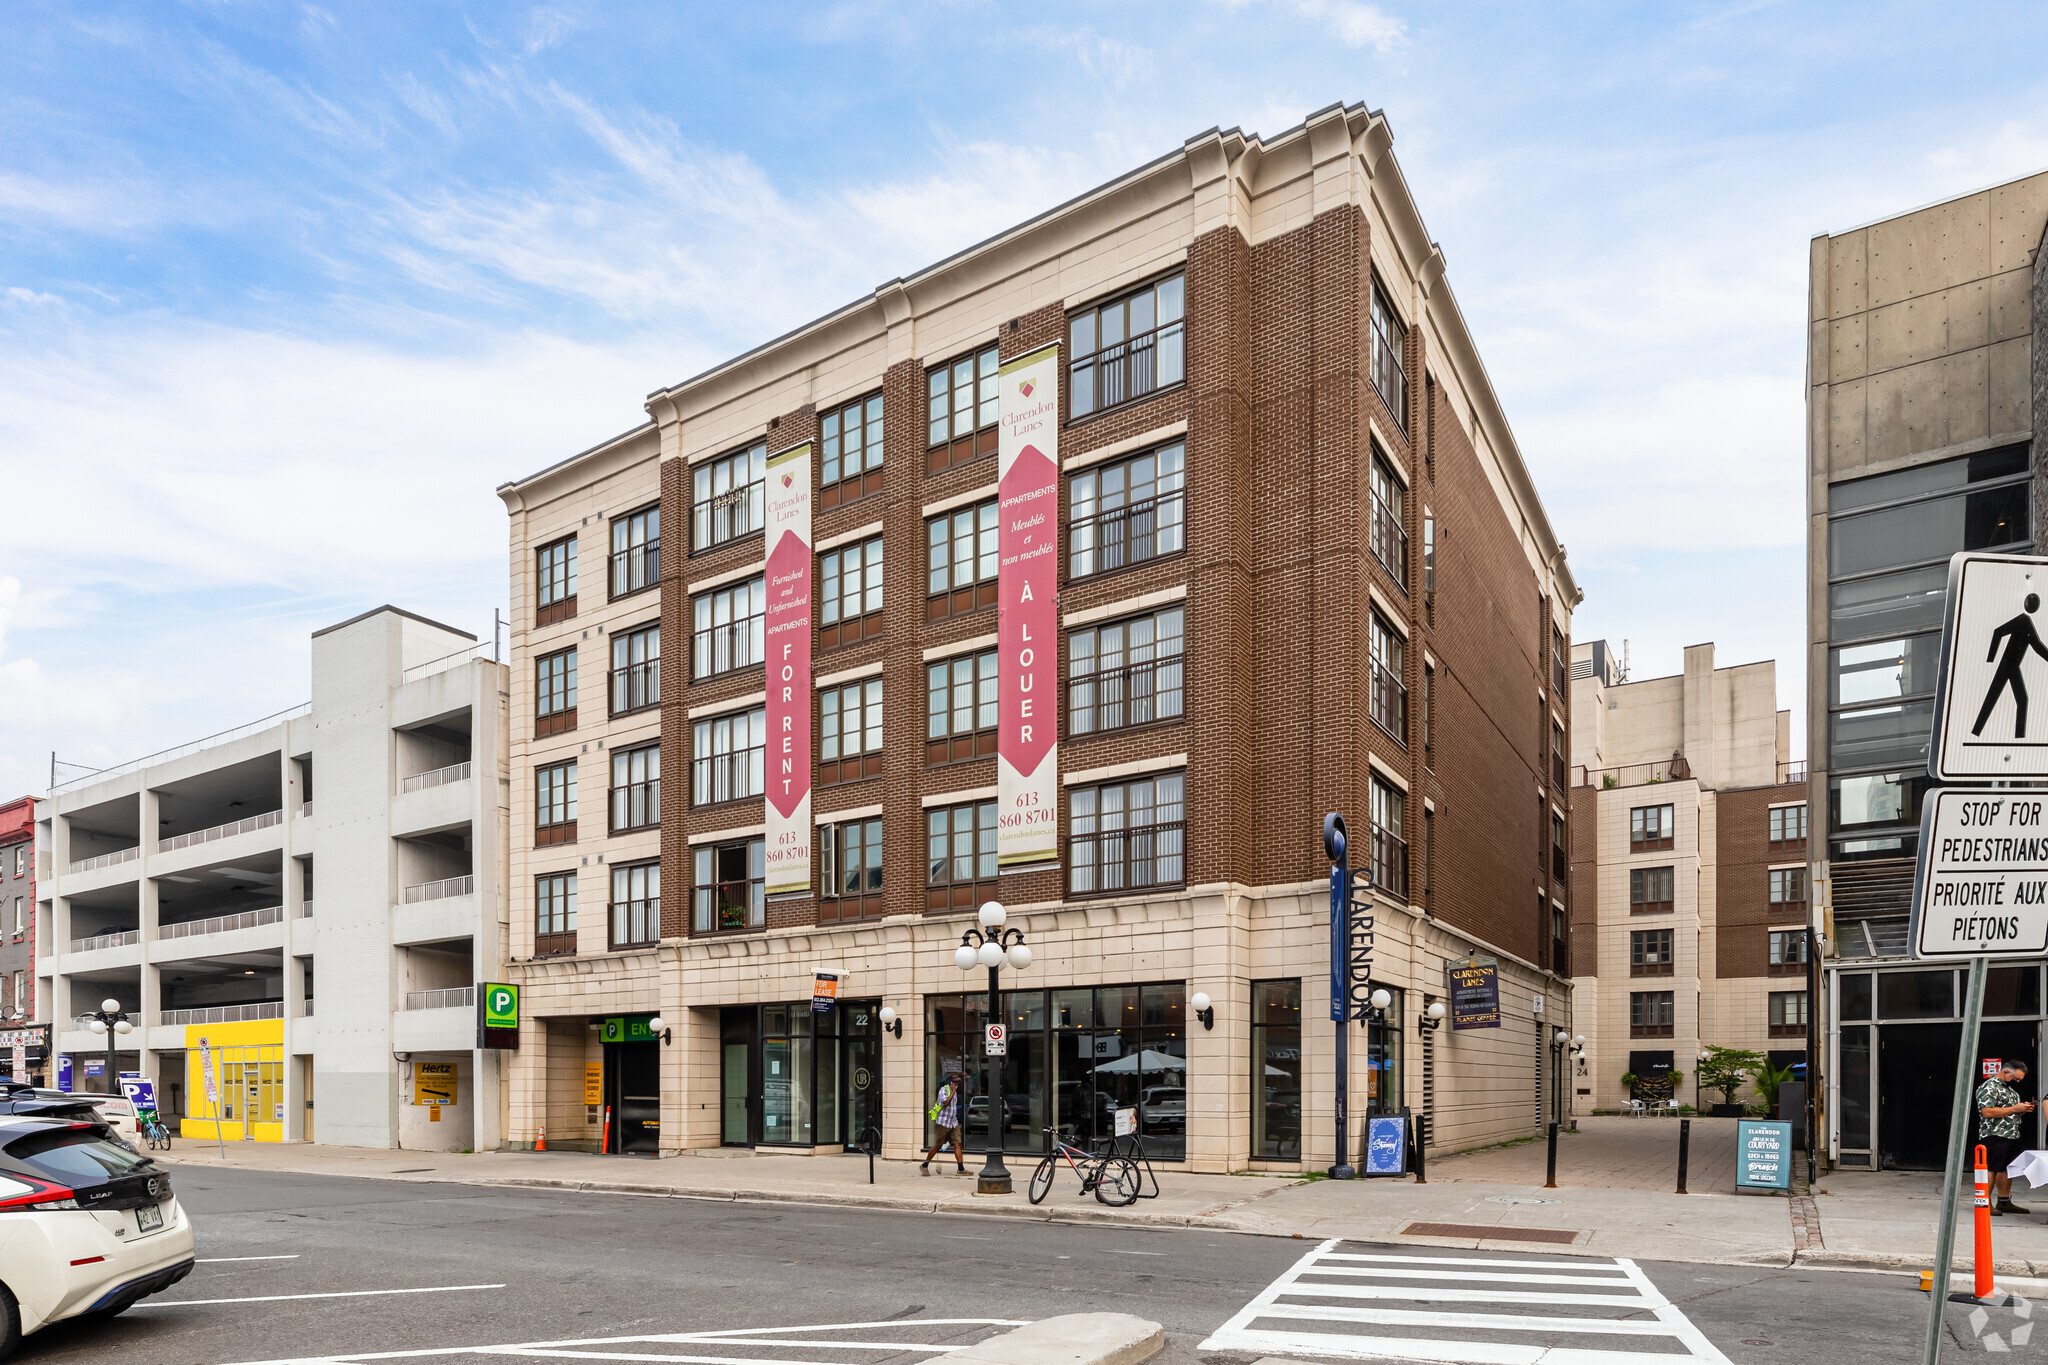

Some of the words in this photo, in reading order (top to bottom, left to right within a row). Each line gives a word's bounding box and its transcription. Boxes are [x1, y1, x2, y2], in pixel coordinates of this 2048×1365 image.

[1002, 402, 1054, 428] Clarendon
[1013, 418, 1043, 437] Lanes
[768, 492, 808, 514] Clarendon
[1001, 484, 1056, 509] APPARTEMENTS
[776, 508, 800, 522] Lanes
[1011, 514, 1046, 534] Meublés
[1023, 535, 1032, 545] et
[1002, 553, 1018, 567] non
[1020, 542, 1054, 562] meublés
[772, 568, 804, 587] Furnished
[781, 585, 794, 597] and
[1020, 580, 1034, 603] À
[768, 594, 807, 616] Unfurnished
[767, 617, 809, 636] APARTMENTS
[781, 643, 793, 703] FOR
[1019, 623, 1035, 744] LOUER
[782, 715, 793, 796] RENT
[1016, 791, 1039, 808] 613
[999, 812, 1022, 829] 860
[1025, 807, 1056, 825] 8701
[1960, 801, 2001, 827] STOP
[2009, 802, 2042, 827] FOR
[778, 830, 797, 846] 613
[999, 827, 1056, 841] clarendonlanes.ca
[766, 848, 784, 864] 860
[786, 845, 810, 861] 8701
[1941, 838, 2048, 863] PEDESTRIANS
[1933, 875, 2006, 907] PRIORITÉ
[2014, 881, 2048, 905] AUX
[1952, 910, 2020, 941] PIÉTONS
[1350, 867, 1374, 1020] CLARENDON
[1453, 968, 1494, 979] CLARENDON
[1462, 978, 1485, 988] LANES
[815, 988, 833, 997] LEASE
[816, 980, 828, 988] FOR
[496, 992, 510, 1012] P
[856, 1014, 868, 1026] 22
[59, 1058, 73, 1072] P
[422, 1064, 451, 1073] Hertz
[1577, 1068, 1588, 1077] 24
[124, 1084, 141, 1098] P
[1748, 1140, 1780, 1150] COURTYARD
[1748, 1162, 1778, 1171] Brunch
[90, 1191, 113, 1200] LEAF
